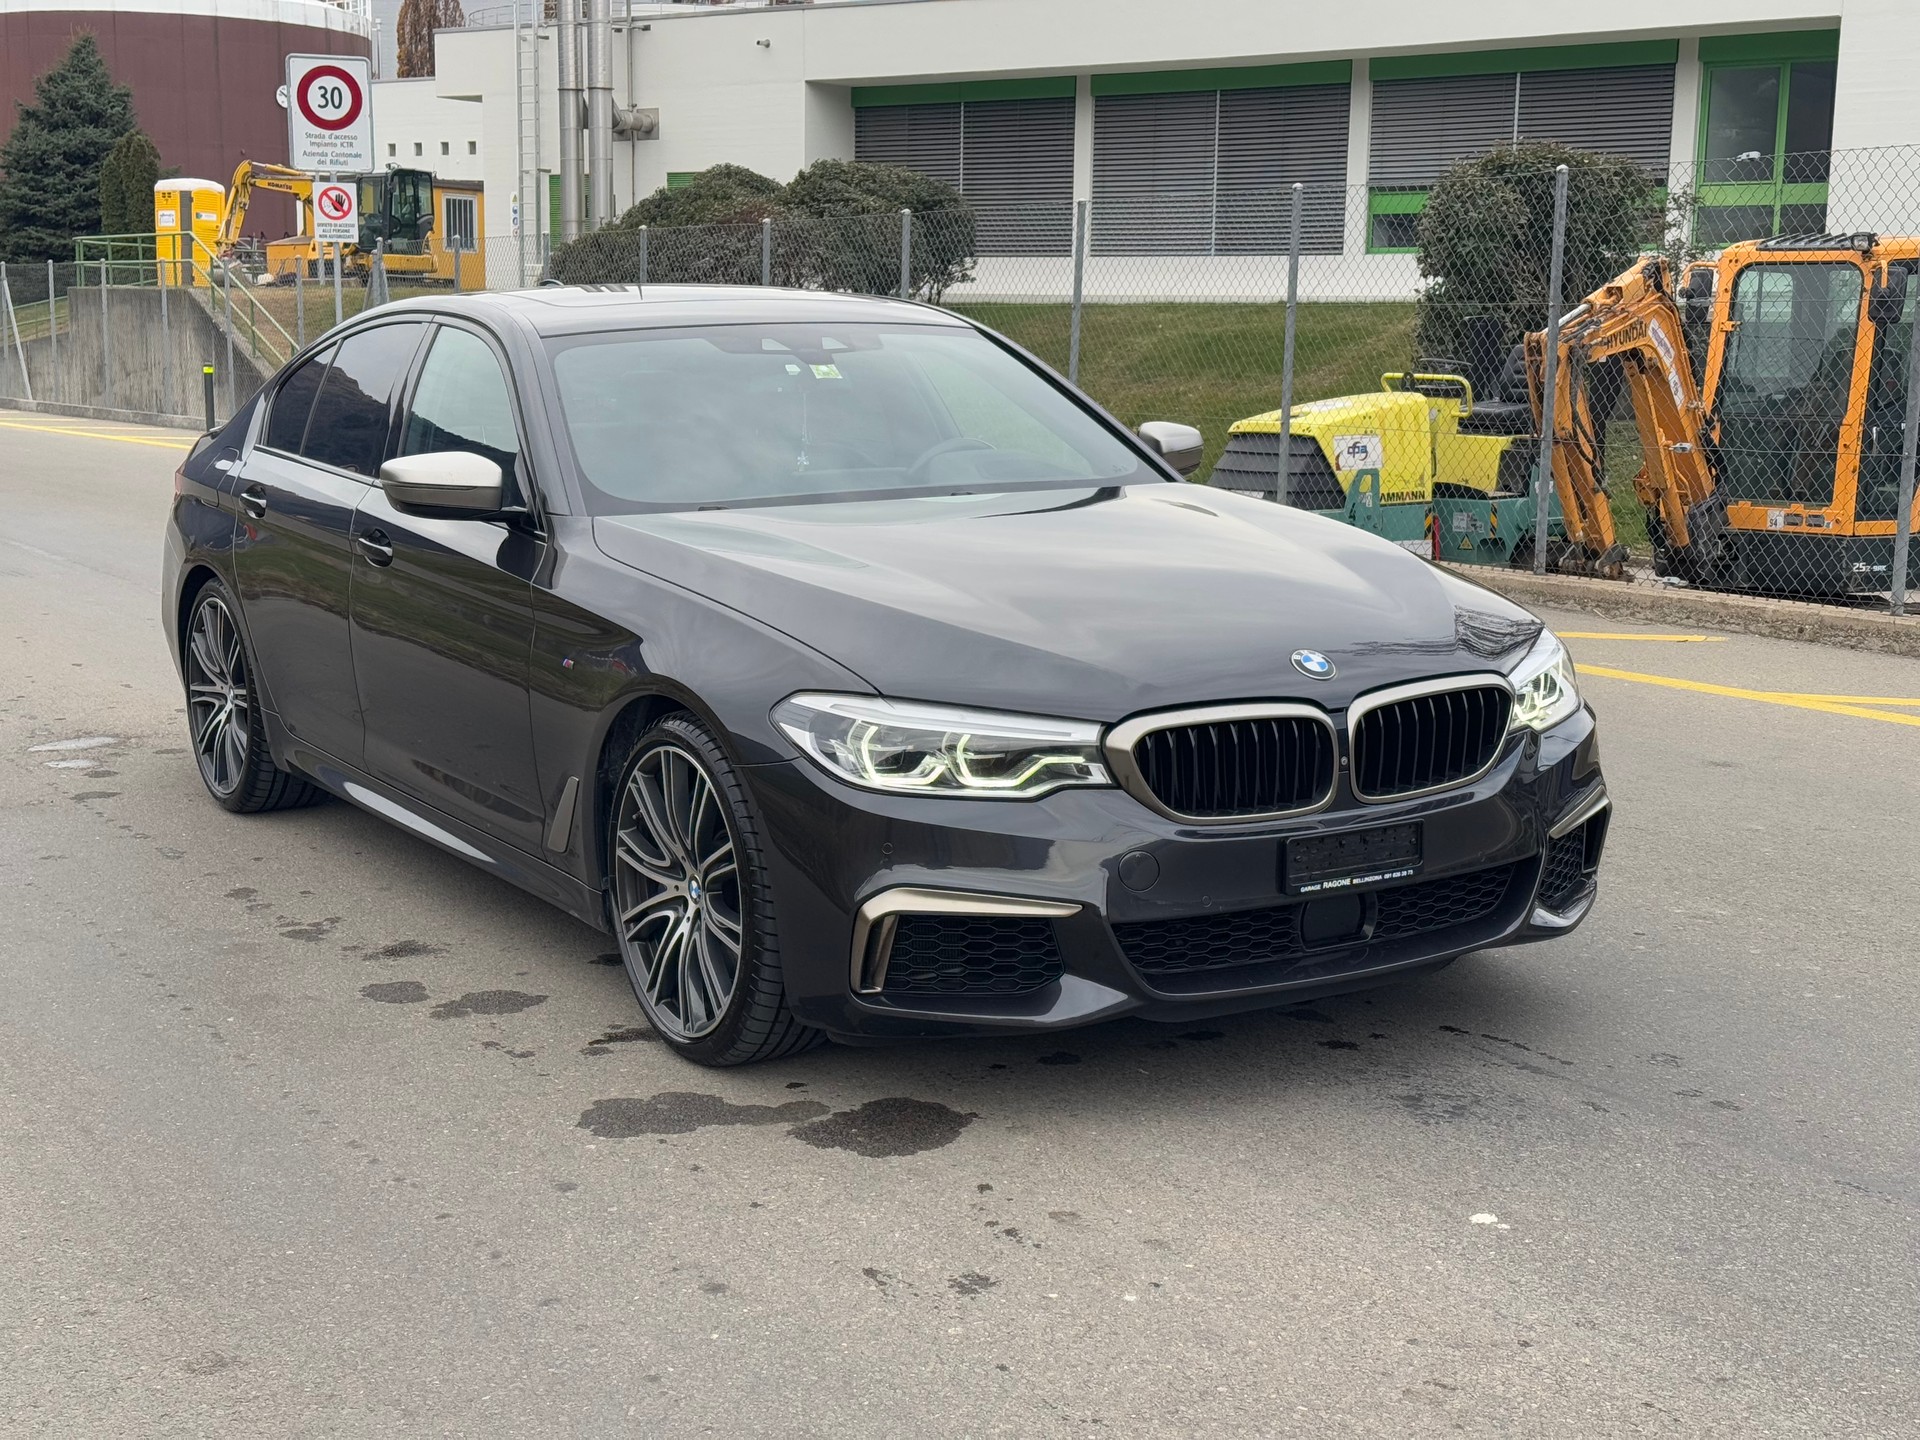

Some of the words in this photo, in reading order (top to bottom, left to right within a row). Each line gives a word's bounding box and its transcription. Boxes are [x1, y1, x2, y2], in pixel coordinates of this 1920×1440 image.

[318, 86, 342, 109] 30
[305, 132, 325, 140] Strada
[302, 150, 328, 158] Azienda
[331, 151, 362, 159] Cantonale
[267, 181, 292, 190] KOMATSU
[1607, 323, 1647, 349] HYUNDAI
[1380, 491, 1425, 502] AMMANN
[1300, 884, 1321, 892] GARAGE
[1323, 878, 1351, 889] RAGONE
[1352, 875, 1382, 884] BELLINZONA
